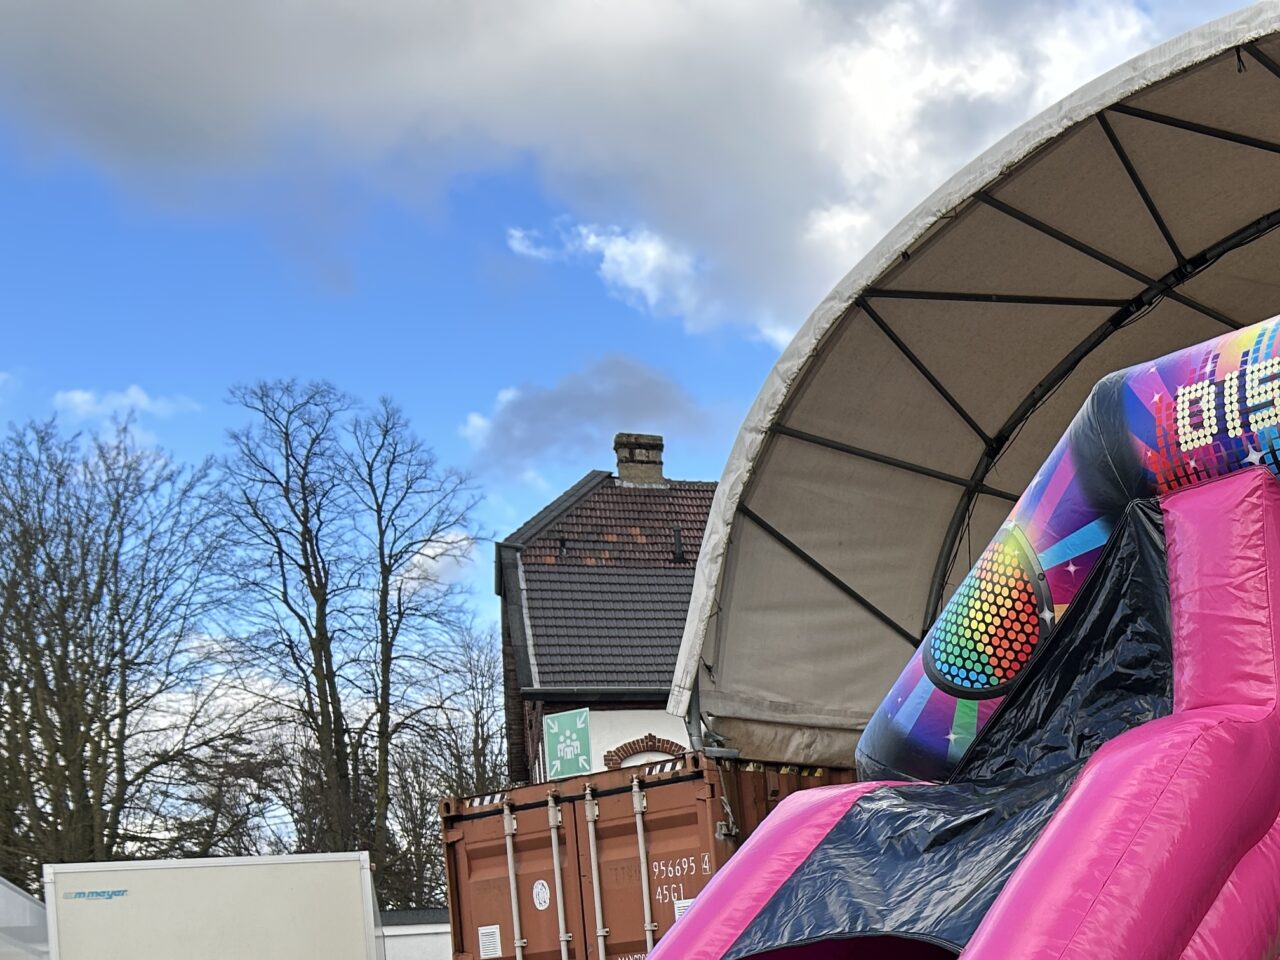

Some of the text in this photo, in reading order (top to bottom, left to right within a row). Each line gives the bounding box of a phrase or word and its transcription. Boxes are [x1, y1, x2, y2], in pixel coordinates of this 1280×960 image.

[653, 857, 696, 879] 956695
[702, 854, 710, 873] 4
[656, 883, 684, 903] 45G1
